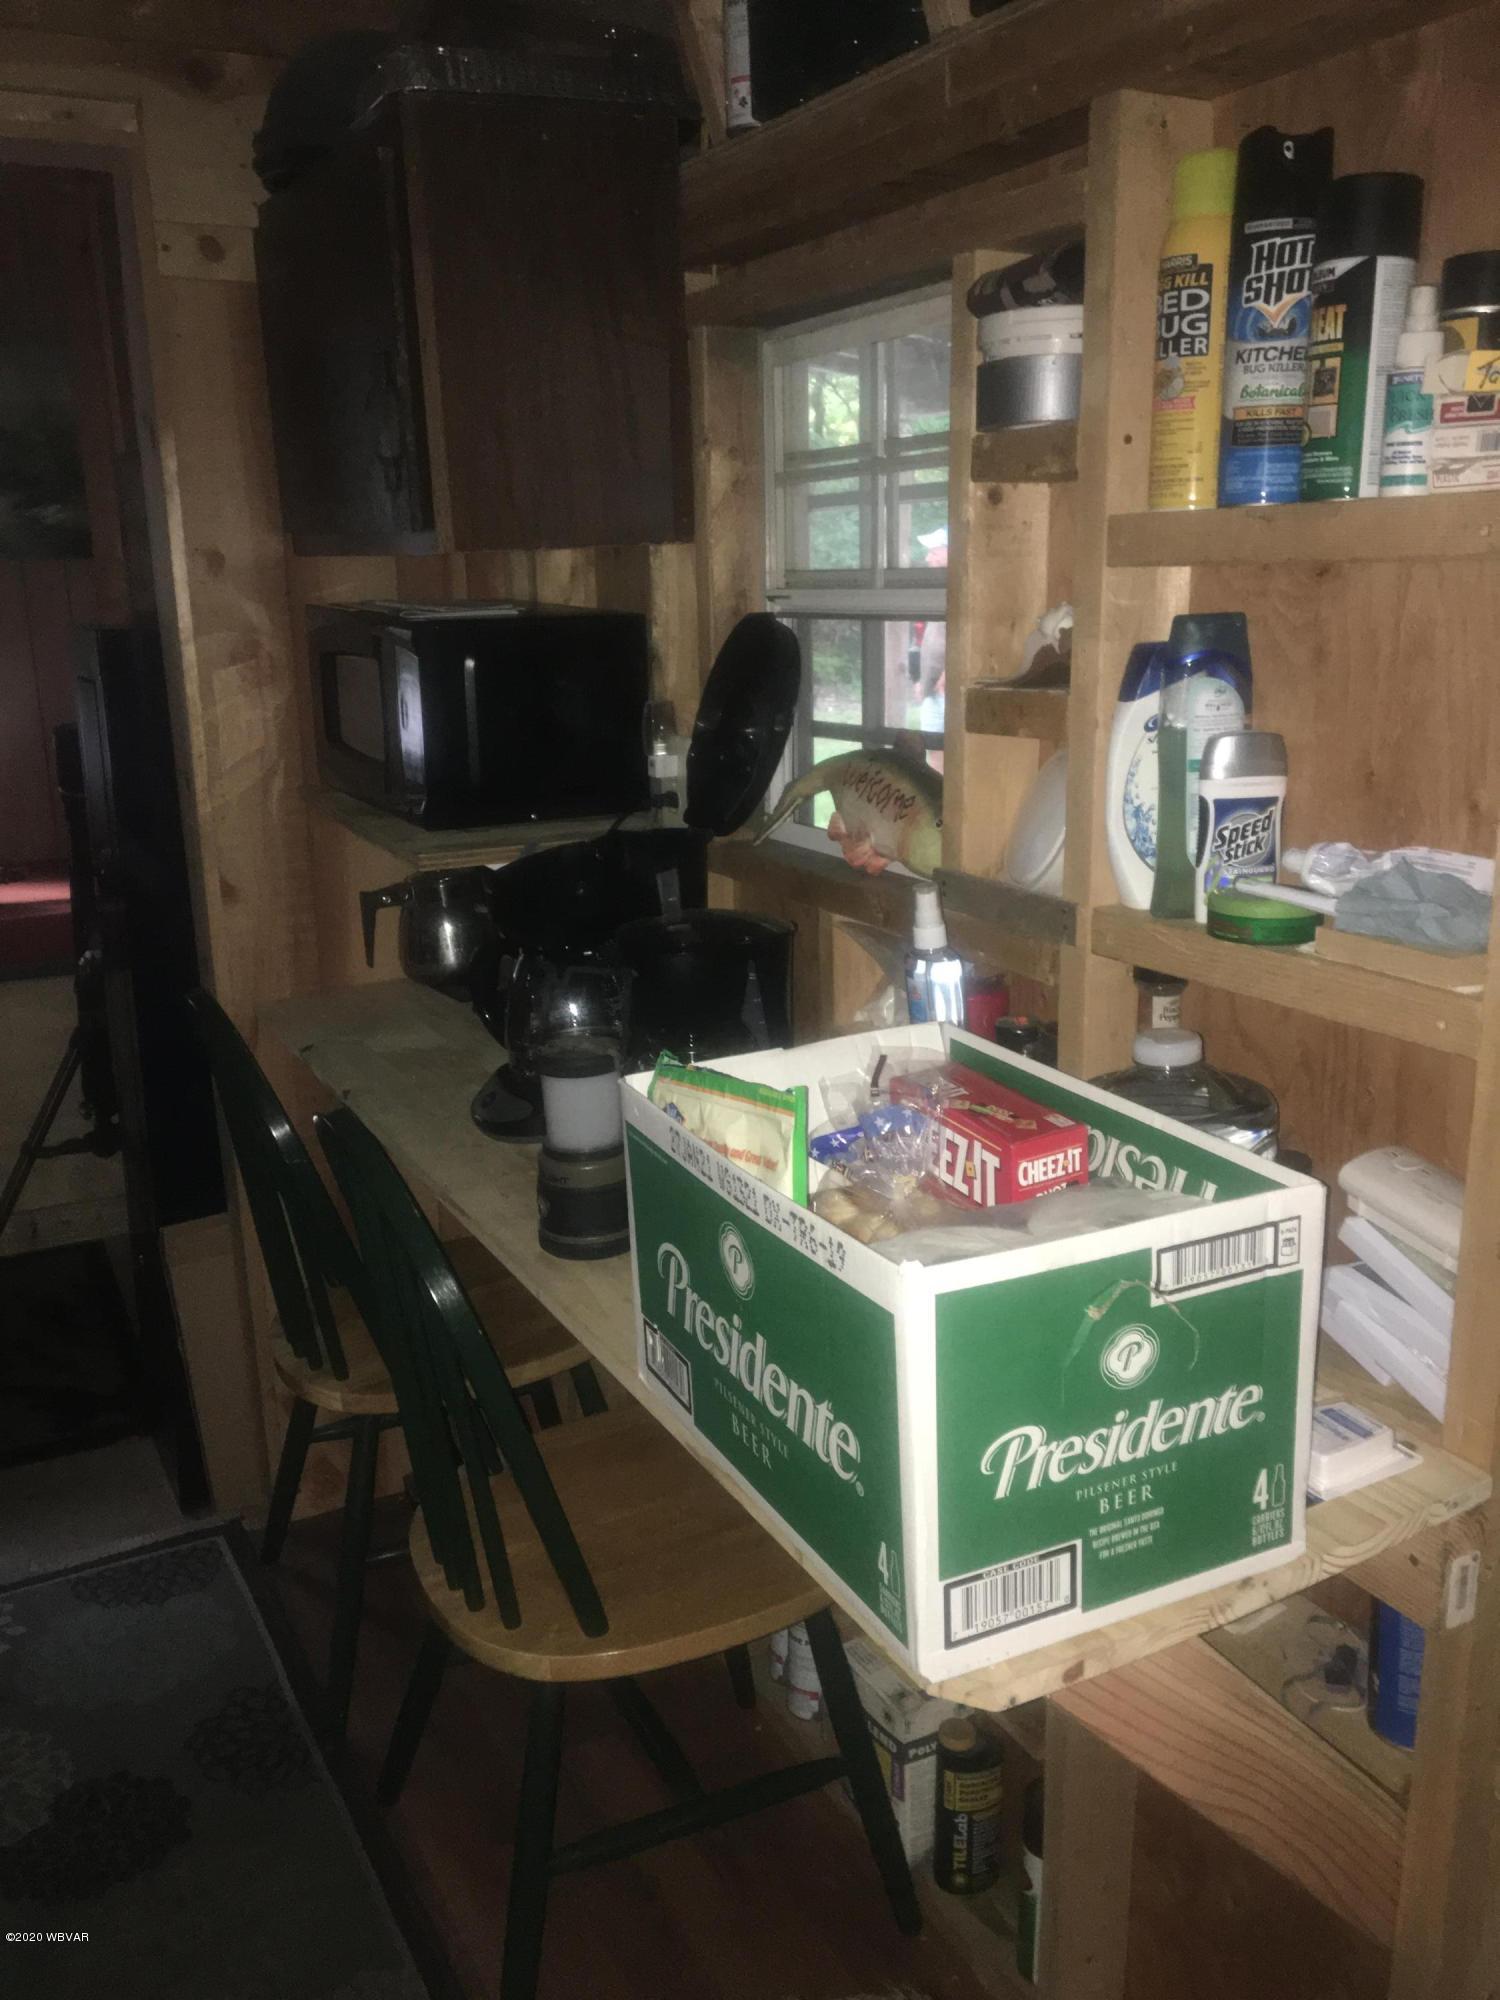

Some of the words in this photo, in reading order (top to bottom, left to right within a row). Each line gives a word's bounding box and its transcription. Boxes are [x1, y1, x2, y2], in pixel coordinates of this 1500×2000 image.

[1251, 234, 1316, 276] HOT
[1174, 272, 1208, 288] KILL
[1157, 313, 1208, 338] UG
[1158, 337, 1208, 357] LLER
[1235, 345, 1308, 365] KITCHE
[1243, 363, 1266, 375] BUG
[1246, 407, 1273, 418] KILLS
[1275, 407, 1297, 417] FAST
[657, 1241, 863, 1485] Presidente
[732, 1412, 775, 1472] BEER
[980, 1383, 1263, 1501] Presidente
[1076, 1474, 1137, 1501] PILSENER
[1142, 1461, 1178, 1481] STYLE
[1252, 1468, 1269, 1510] 4
[1099, 1484, 1154, 1514] BEER
[878, 1541, 889, 1586] 4
[983, 1563, 1010, 1579] CASE
[1012, 1555, 1039, 1571] CODE
[975, 1613, 1009, 1633] 19057
[1014, 1600, 1050, 1620] 00157
